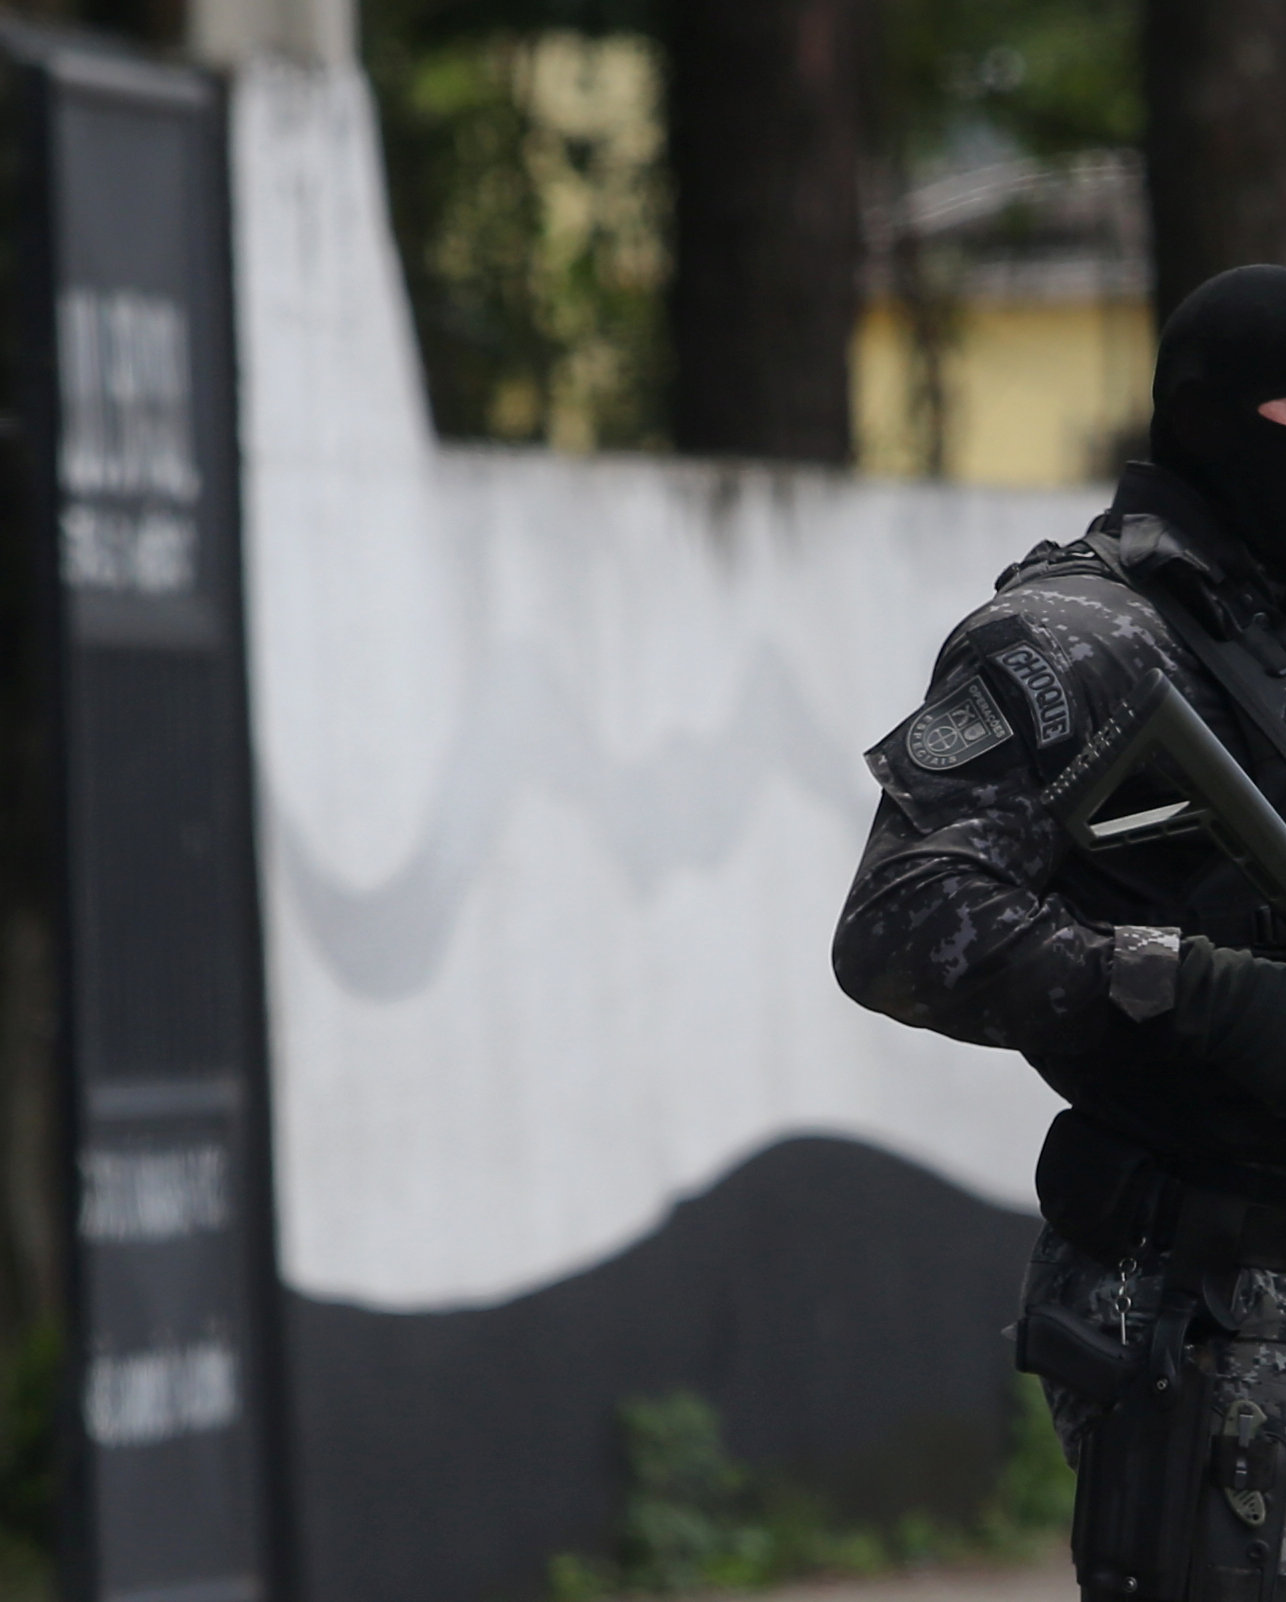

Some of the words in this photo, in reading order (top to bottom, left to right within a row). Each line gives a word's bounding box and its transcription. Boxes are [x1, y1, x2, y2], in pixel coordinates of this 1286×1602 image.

[968, 684, 1006, 738] OPERAÇÕES
[1002, 650, 1067, 739] CHOQUE
[911, 714, 958, 765] ESPECIAIS
